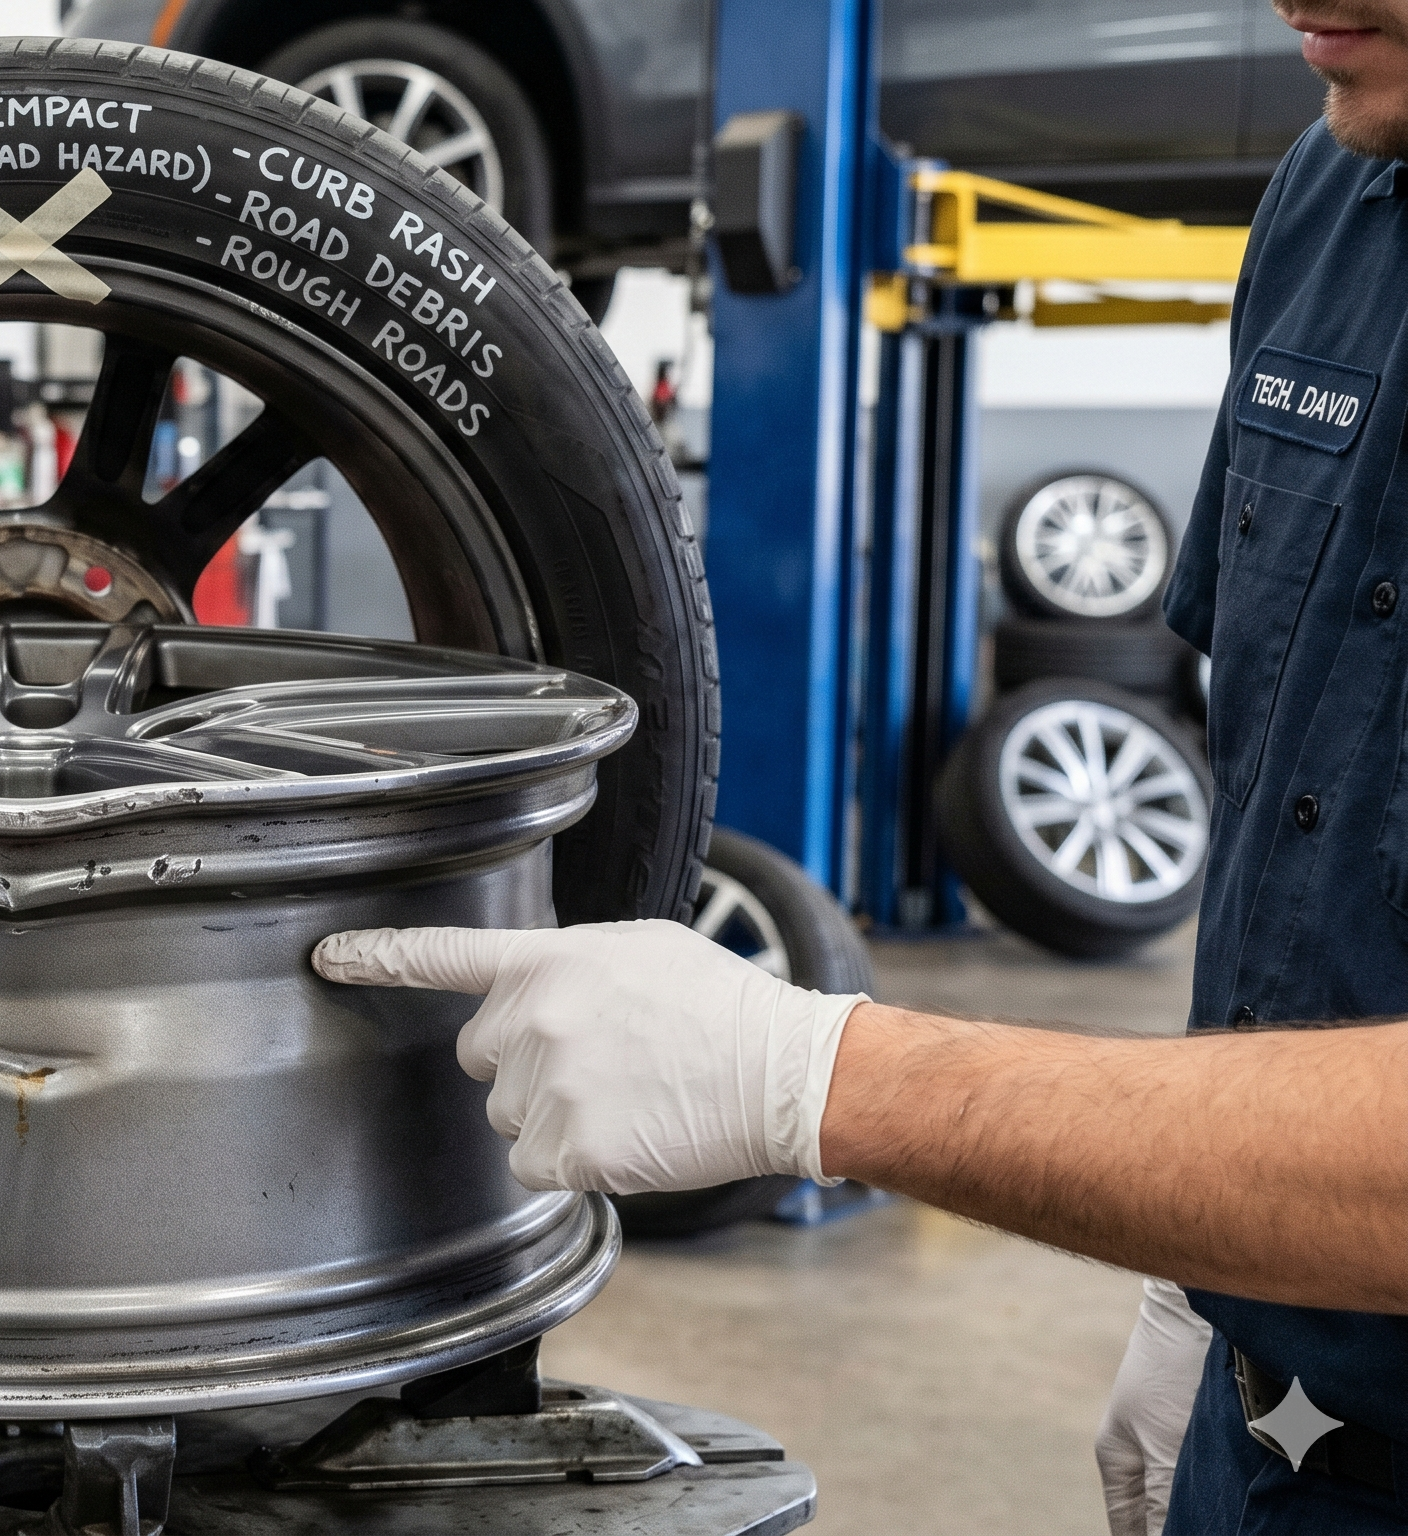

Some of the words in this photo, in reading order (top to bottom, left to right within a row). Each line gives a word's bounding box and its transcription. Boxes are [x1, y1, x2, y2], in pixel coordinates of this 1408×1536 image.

[58, 142, 212, 194] HAZARD)
[389, 210, 500, 306] RASH
[365, 253, 504, 379] DEBRIS
[371, 319, 492, 437] ROADS
[1251, 372, 1296, 412] TECH.
[1296, 385, 1360, 428] DAVID
